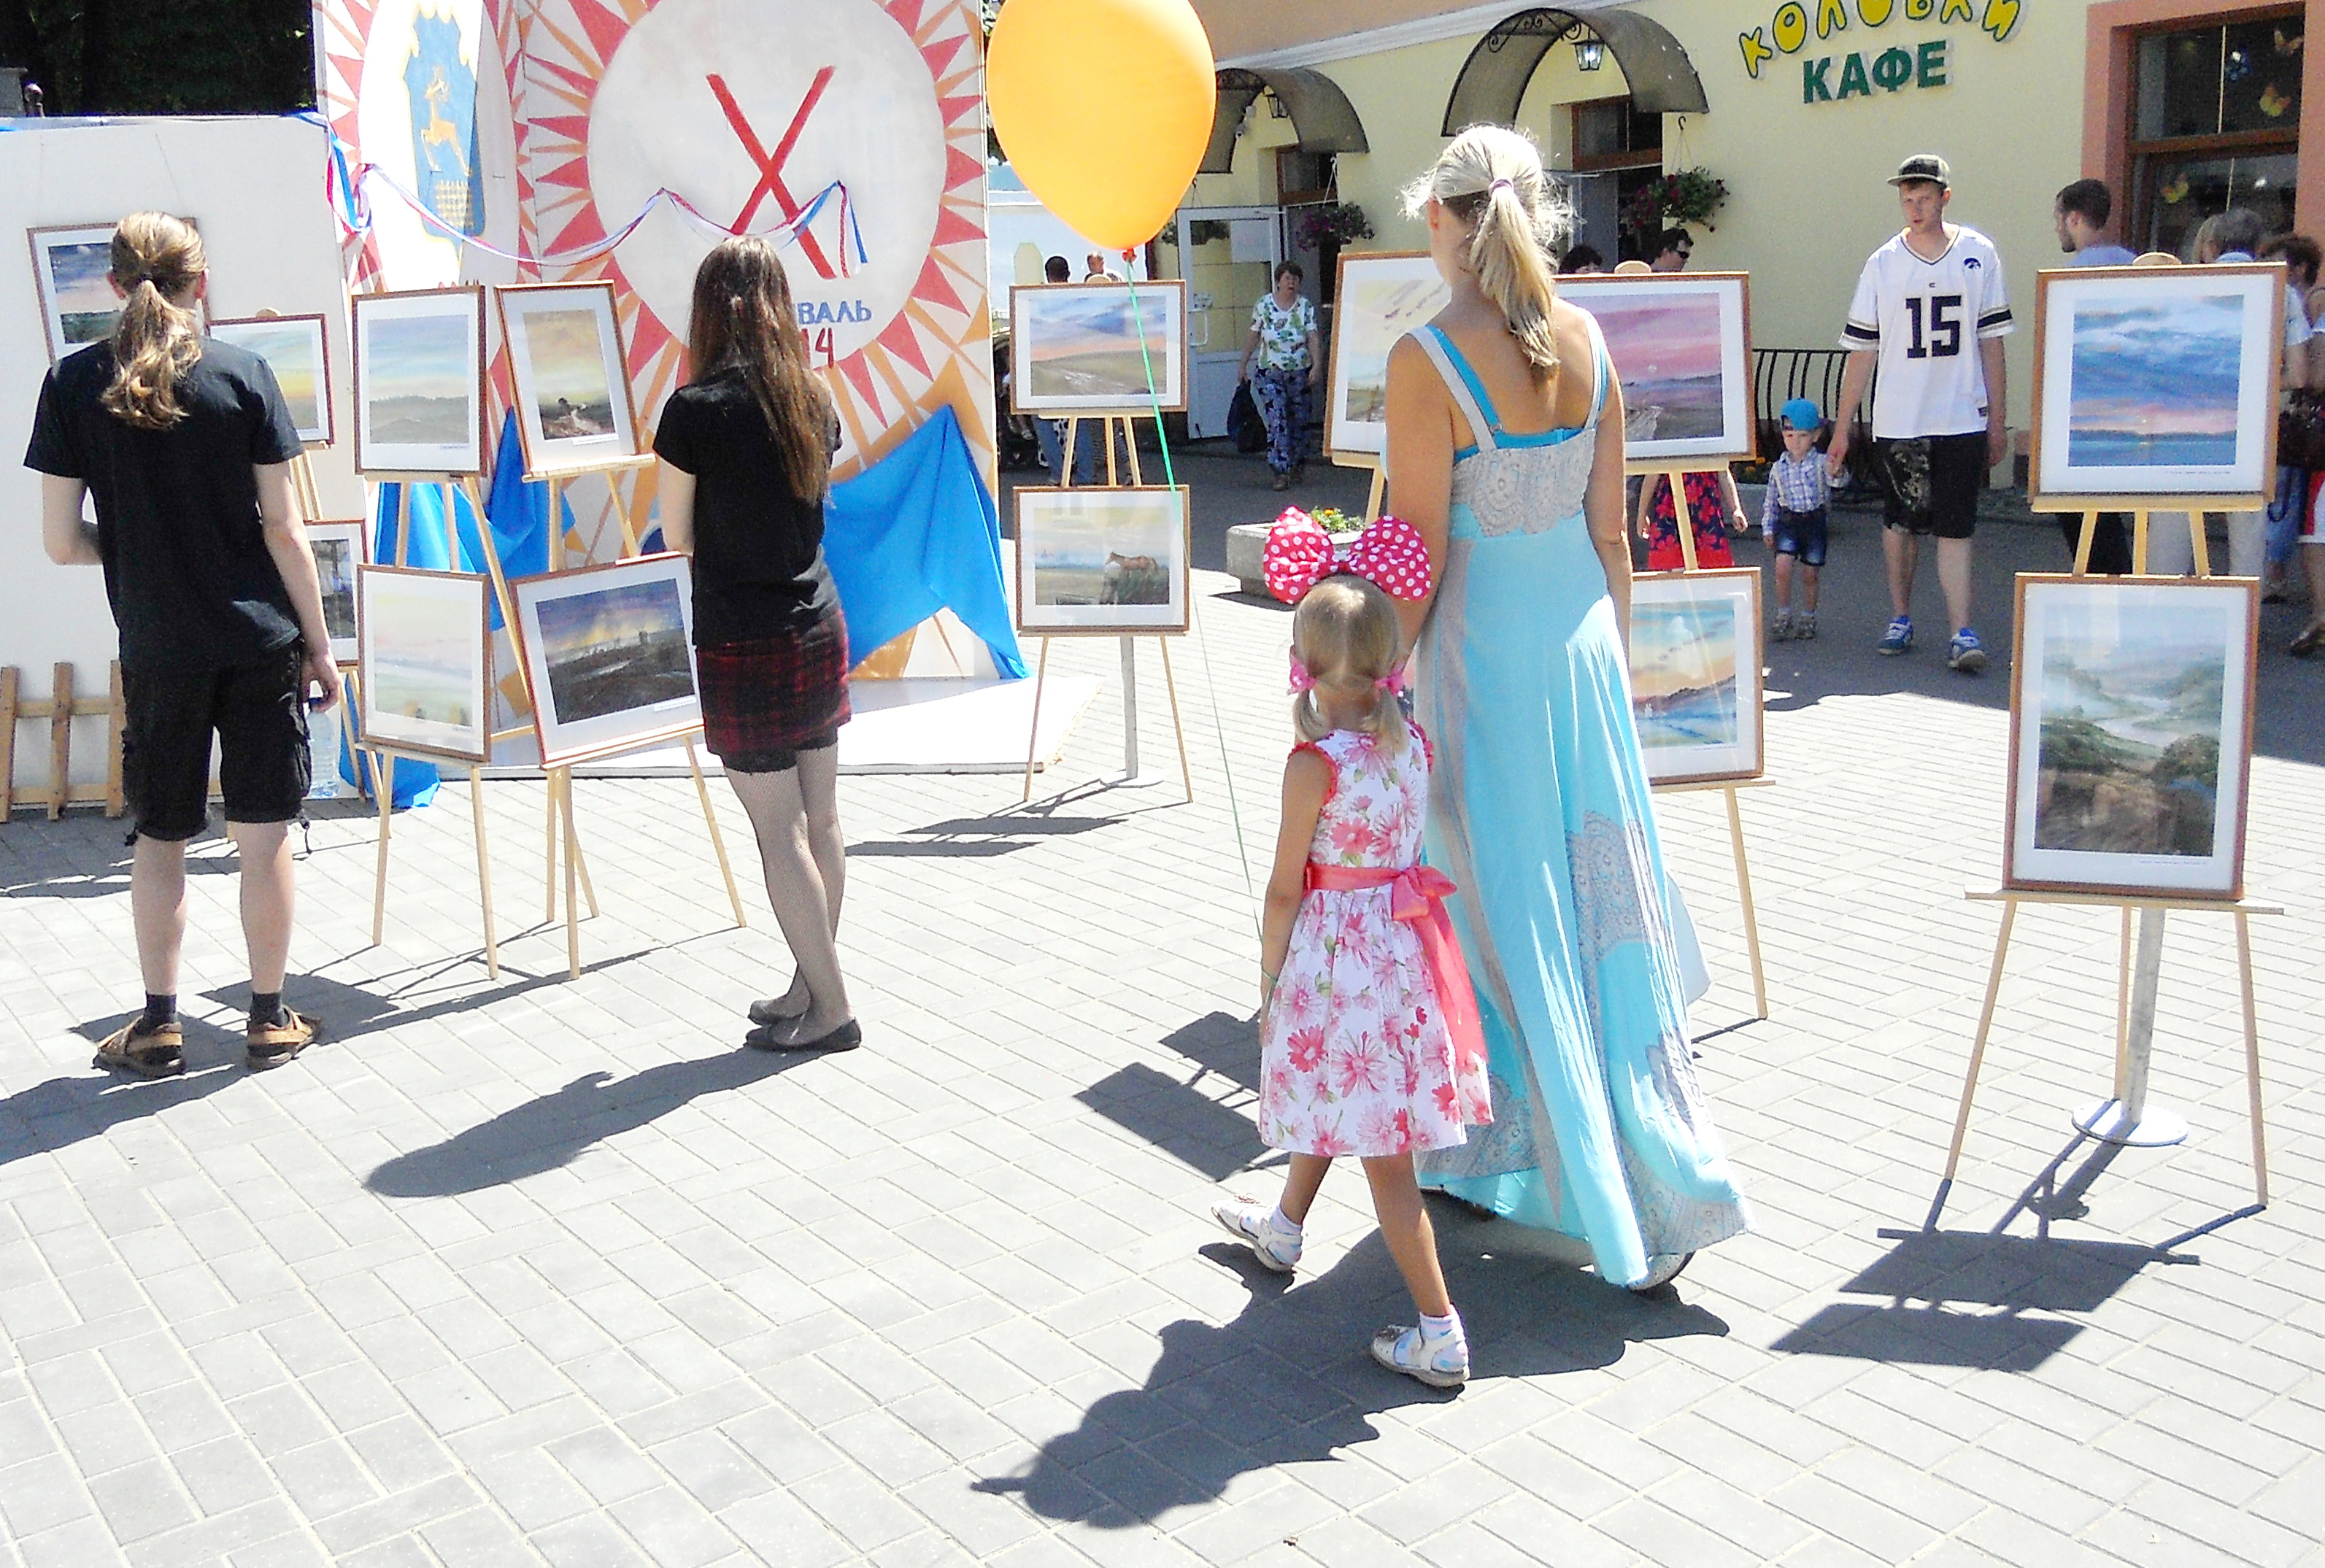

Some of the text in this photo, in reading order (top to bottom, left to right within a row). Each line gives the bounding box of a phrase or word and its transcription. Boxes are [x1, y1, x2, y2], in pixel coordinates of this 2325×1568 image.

[1803, 40, 1946, 104] КАФЕ
[797, 300, 872, 324] ВАЛЬ
[1905, 295, 1962, 358] 15
[800, 327, 834, 369] 14
